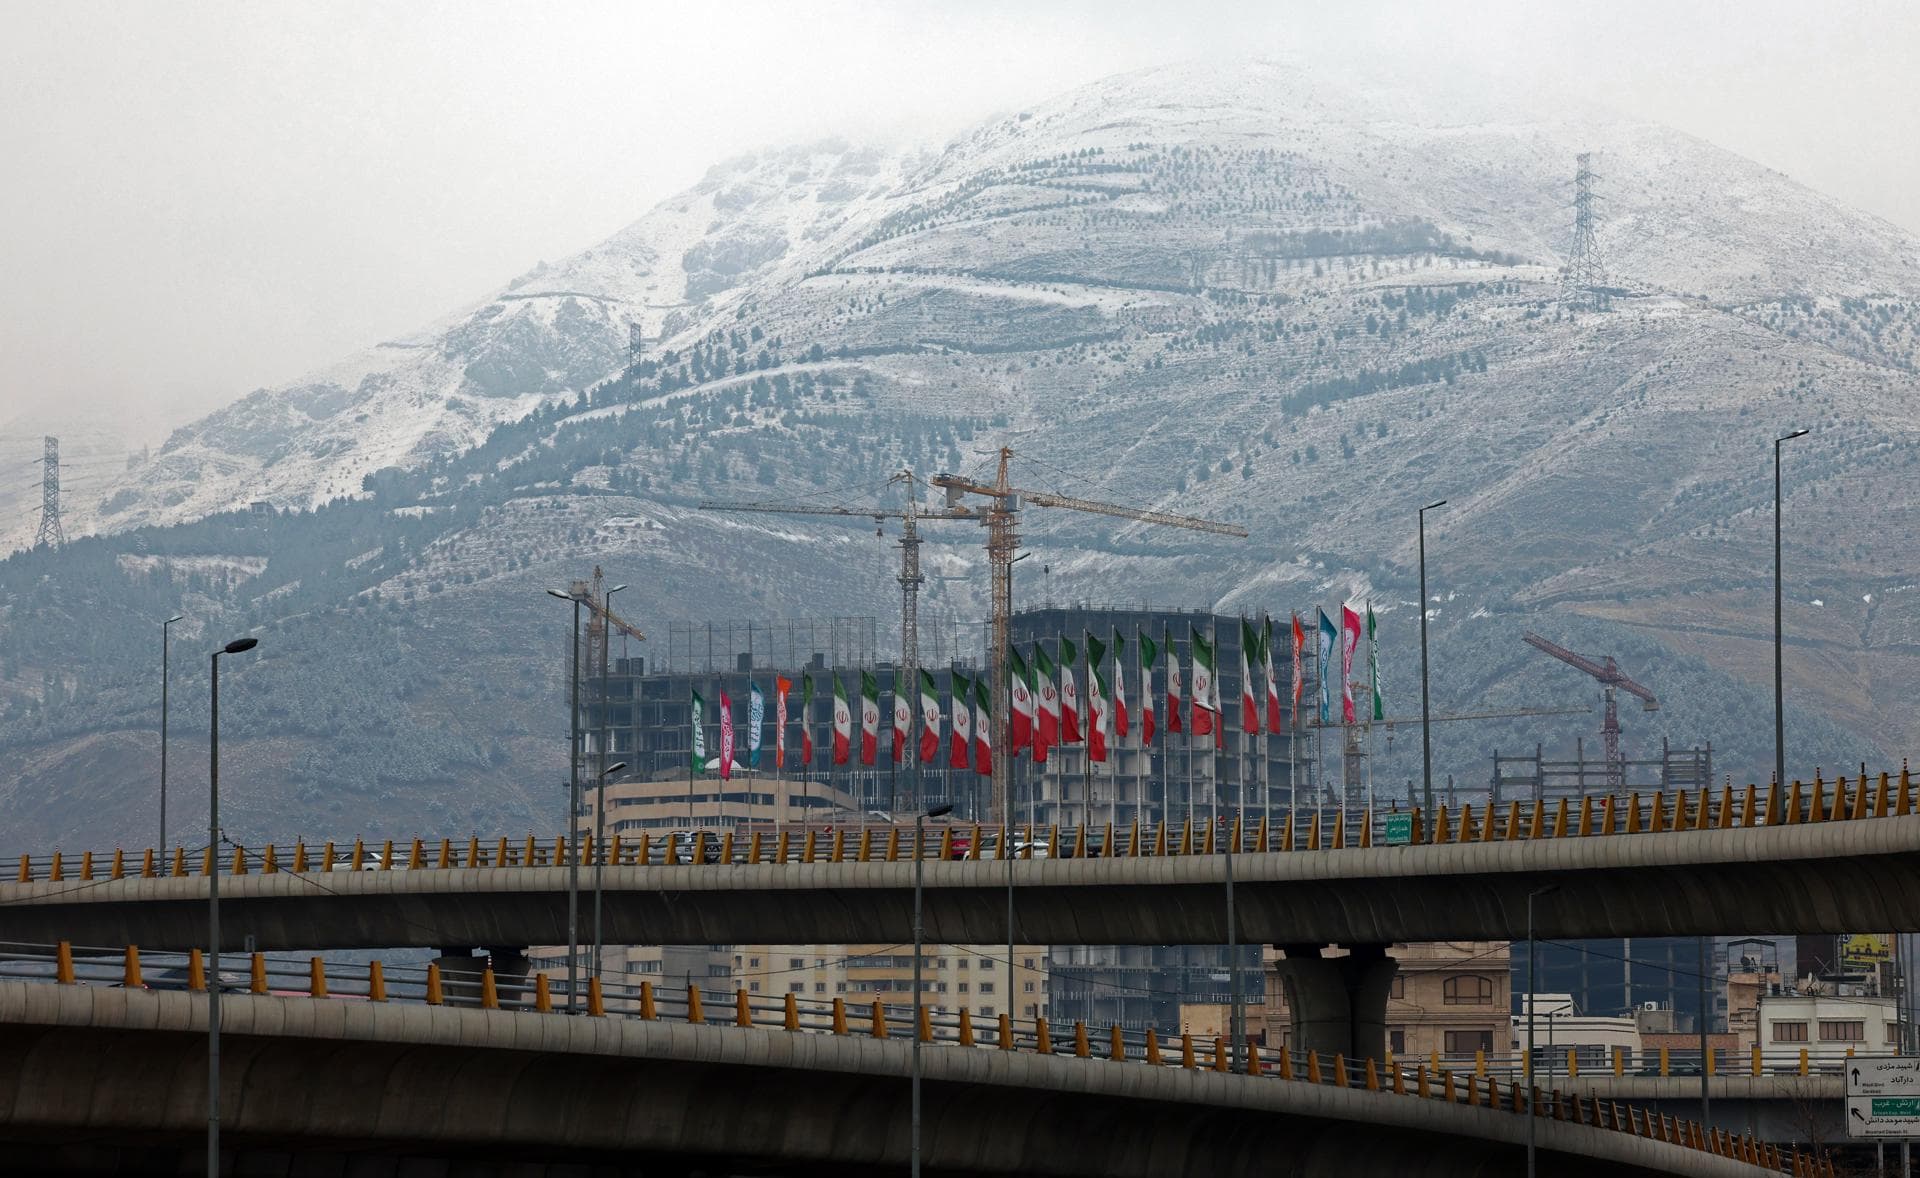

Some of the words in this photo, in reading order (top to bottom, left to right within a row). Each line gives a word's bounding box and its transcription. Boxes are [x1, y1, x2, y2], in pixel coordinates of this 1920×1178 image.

[1896, 1063, 1913, 1071] شهید
[1890, 1076, 1914, 1085] دارآباد
[1874, 1100, 1891, 1108] غرب
[1896, 1099, 1914, 1108] ارتش
[1865, 1117, 1884, 1125] دانش
[1903, 1116, 1919, 1125] شهید
